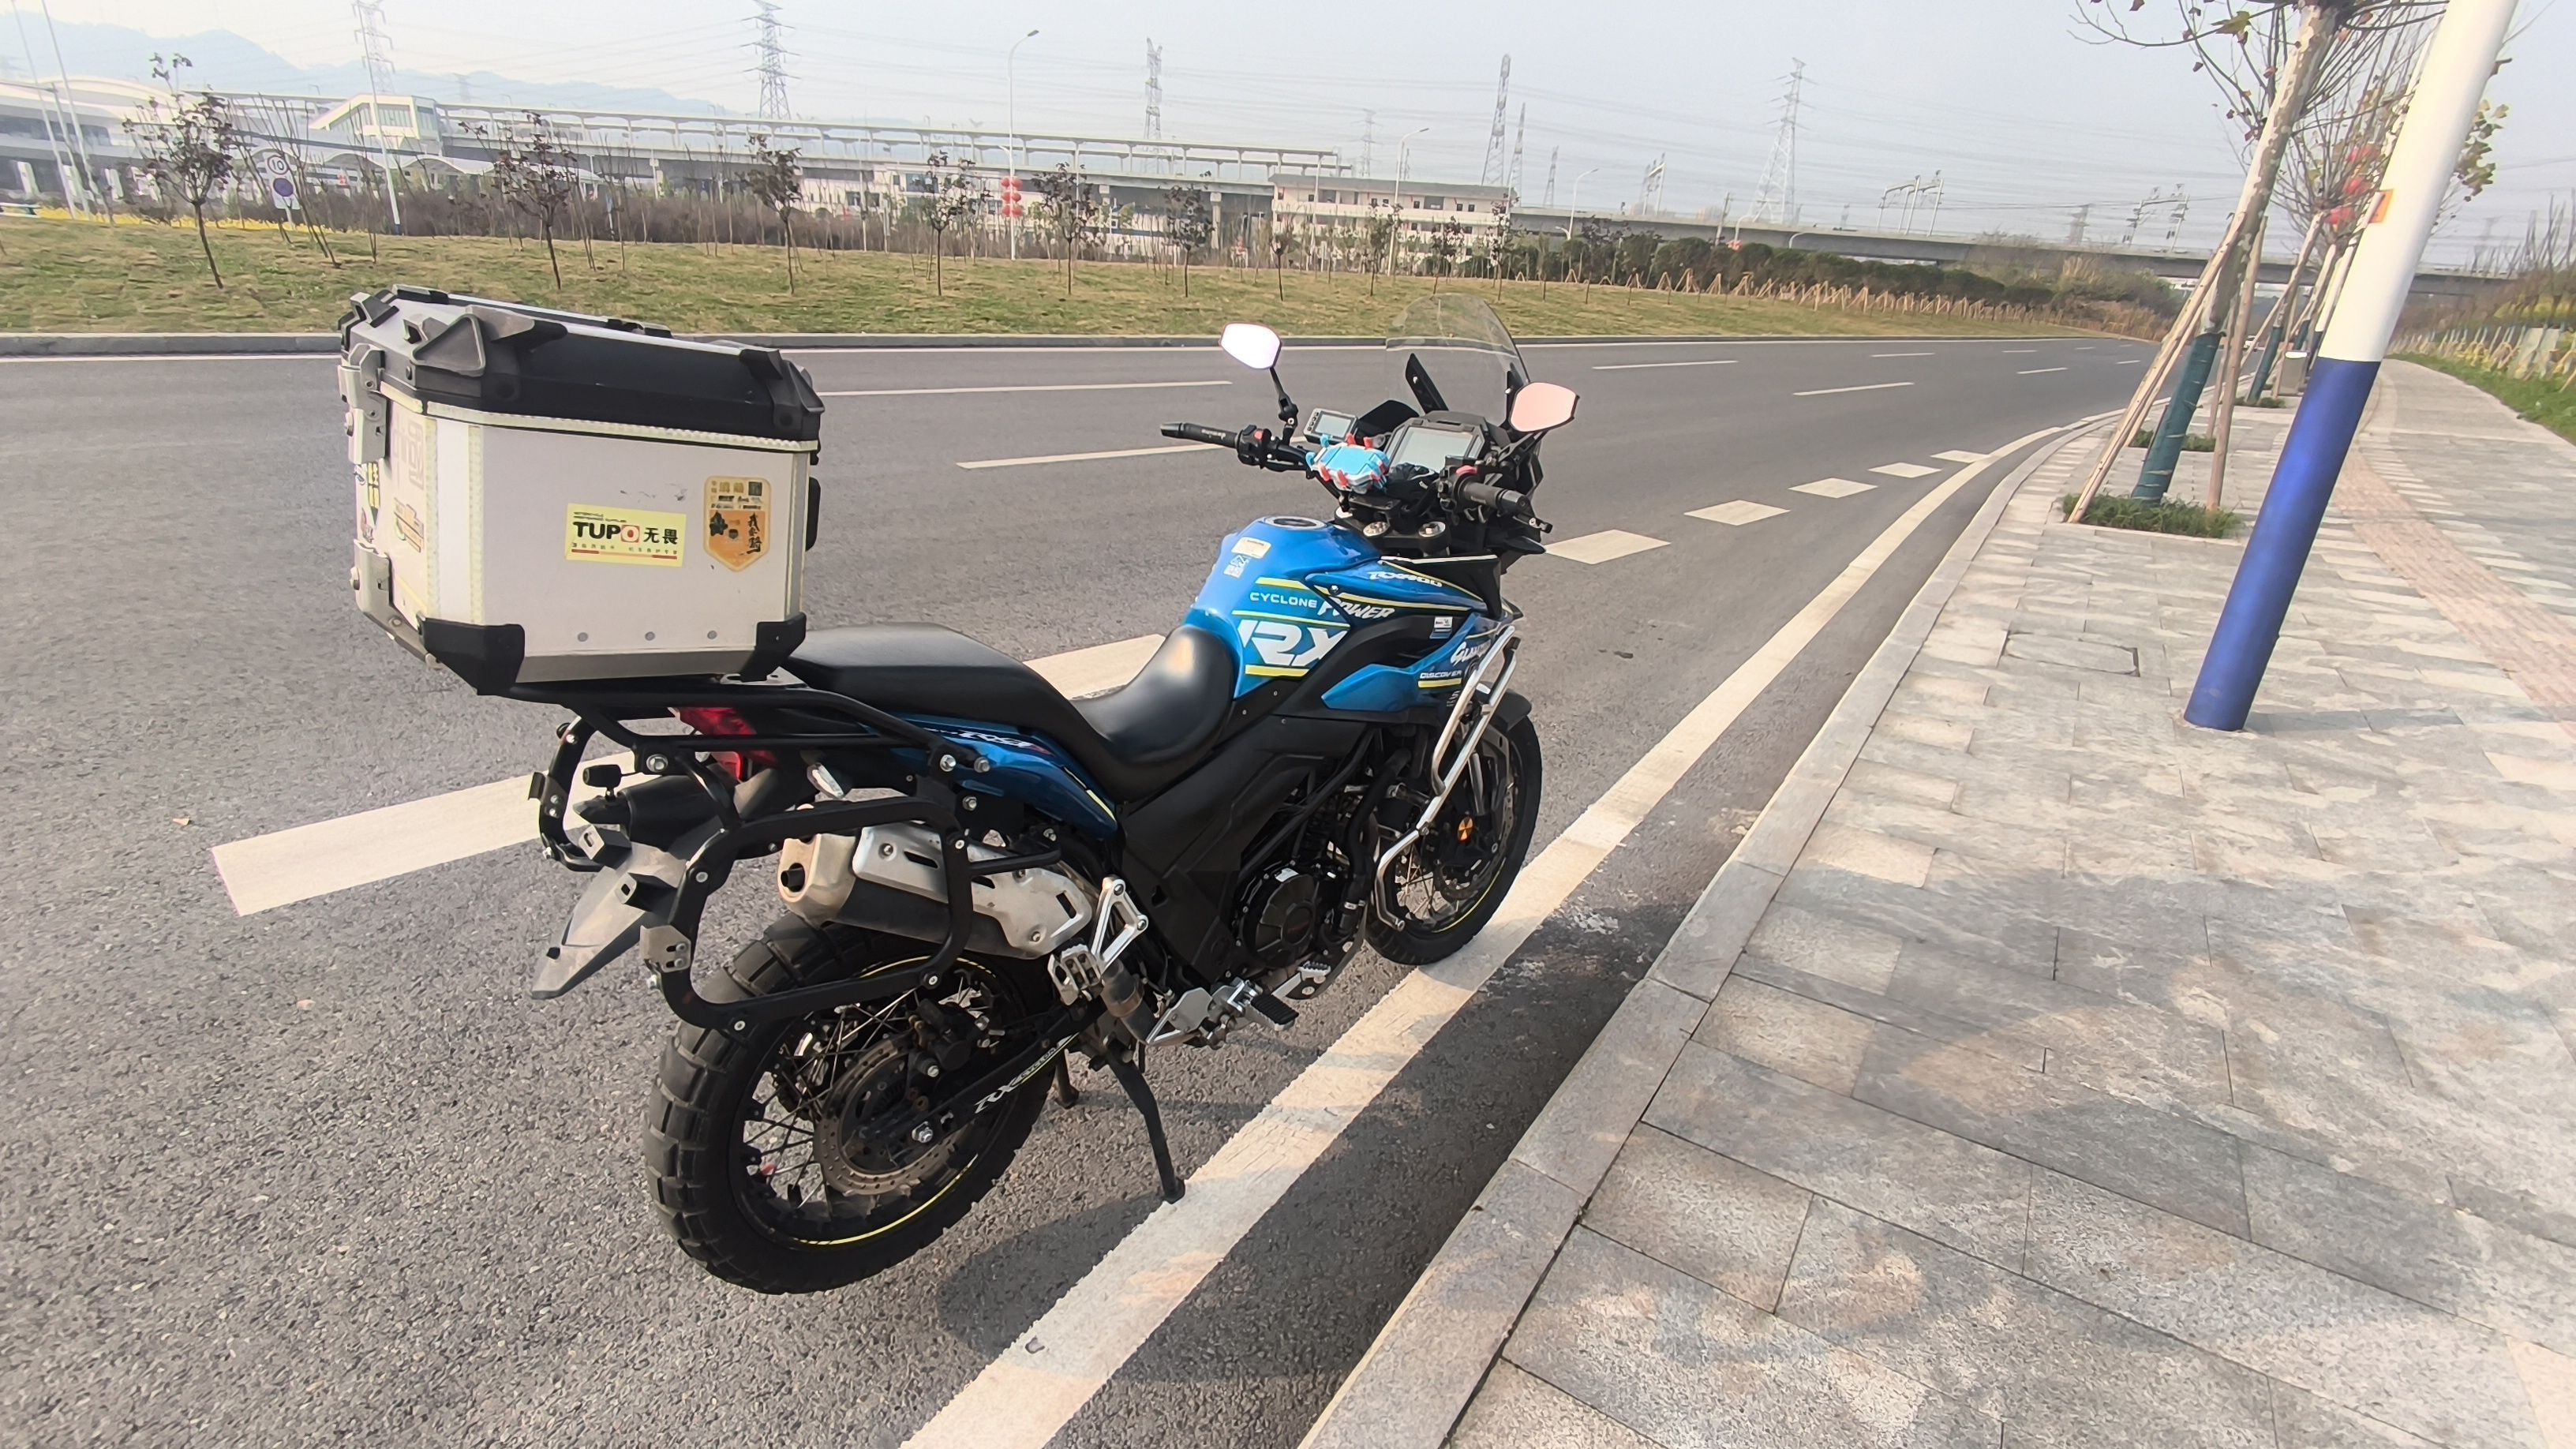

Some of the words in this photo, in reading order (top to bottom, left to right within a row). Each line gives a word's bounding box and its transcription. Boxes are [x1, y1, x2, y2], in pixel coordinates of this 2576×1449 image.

[643, 526, 678, 545] 无畏
[1249, 592, 1318, 609] CYCLONE
[1316, 596, 1395, 620] POWER
[1420, 669, 1463, 680] DISCOVER
